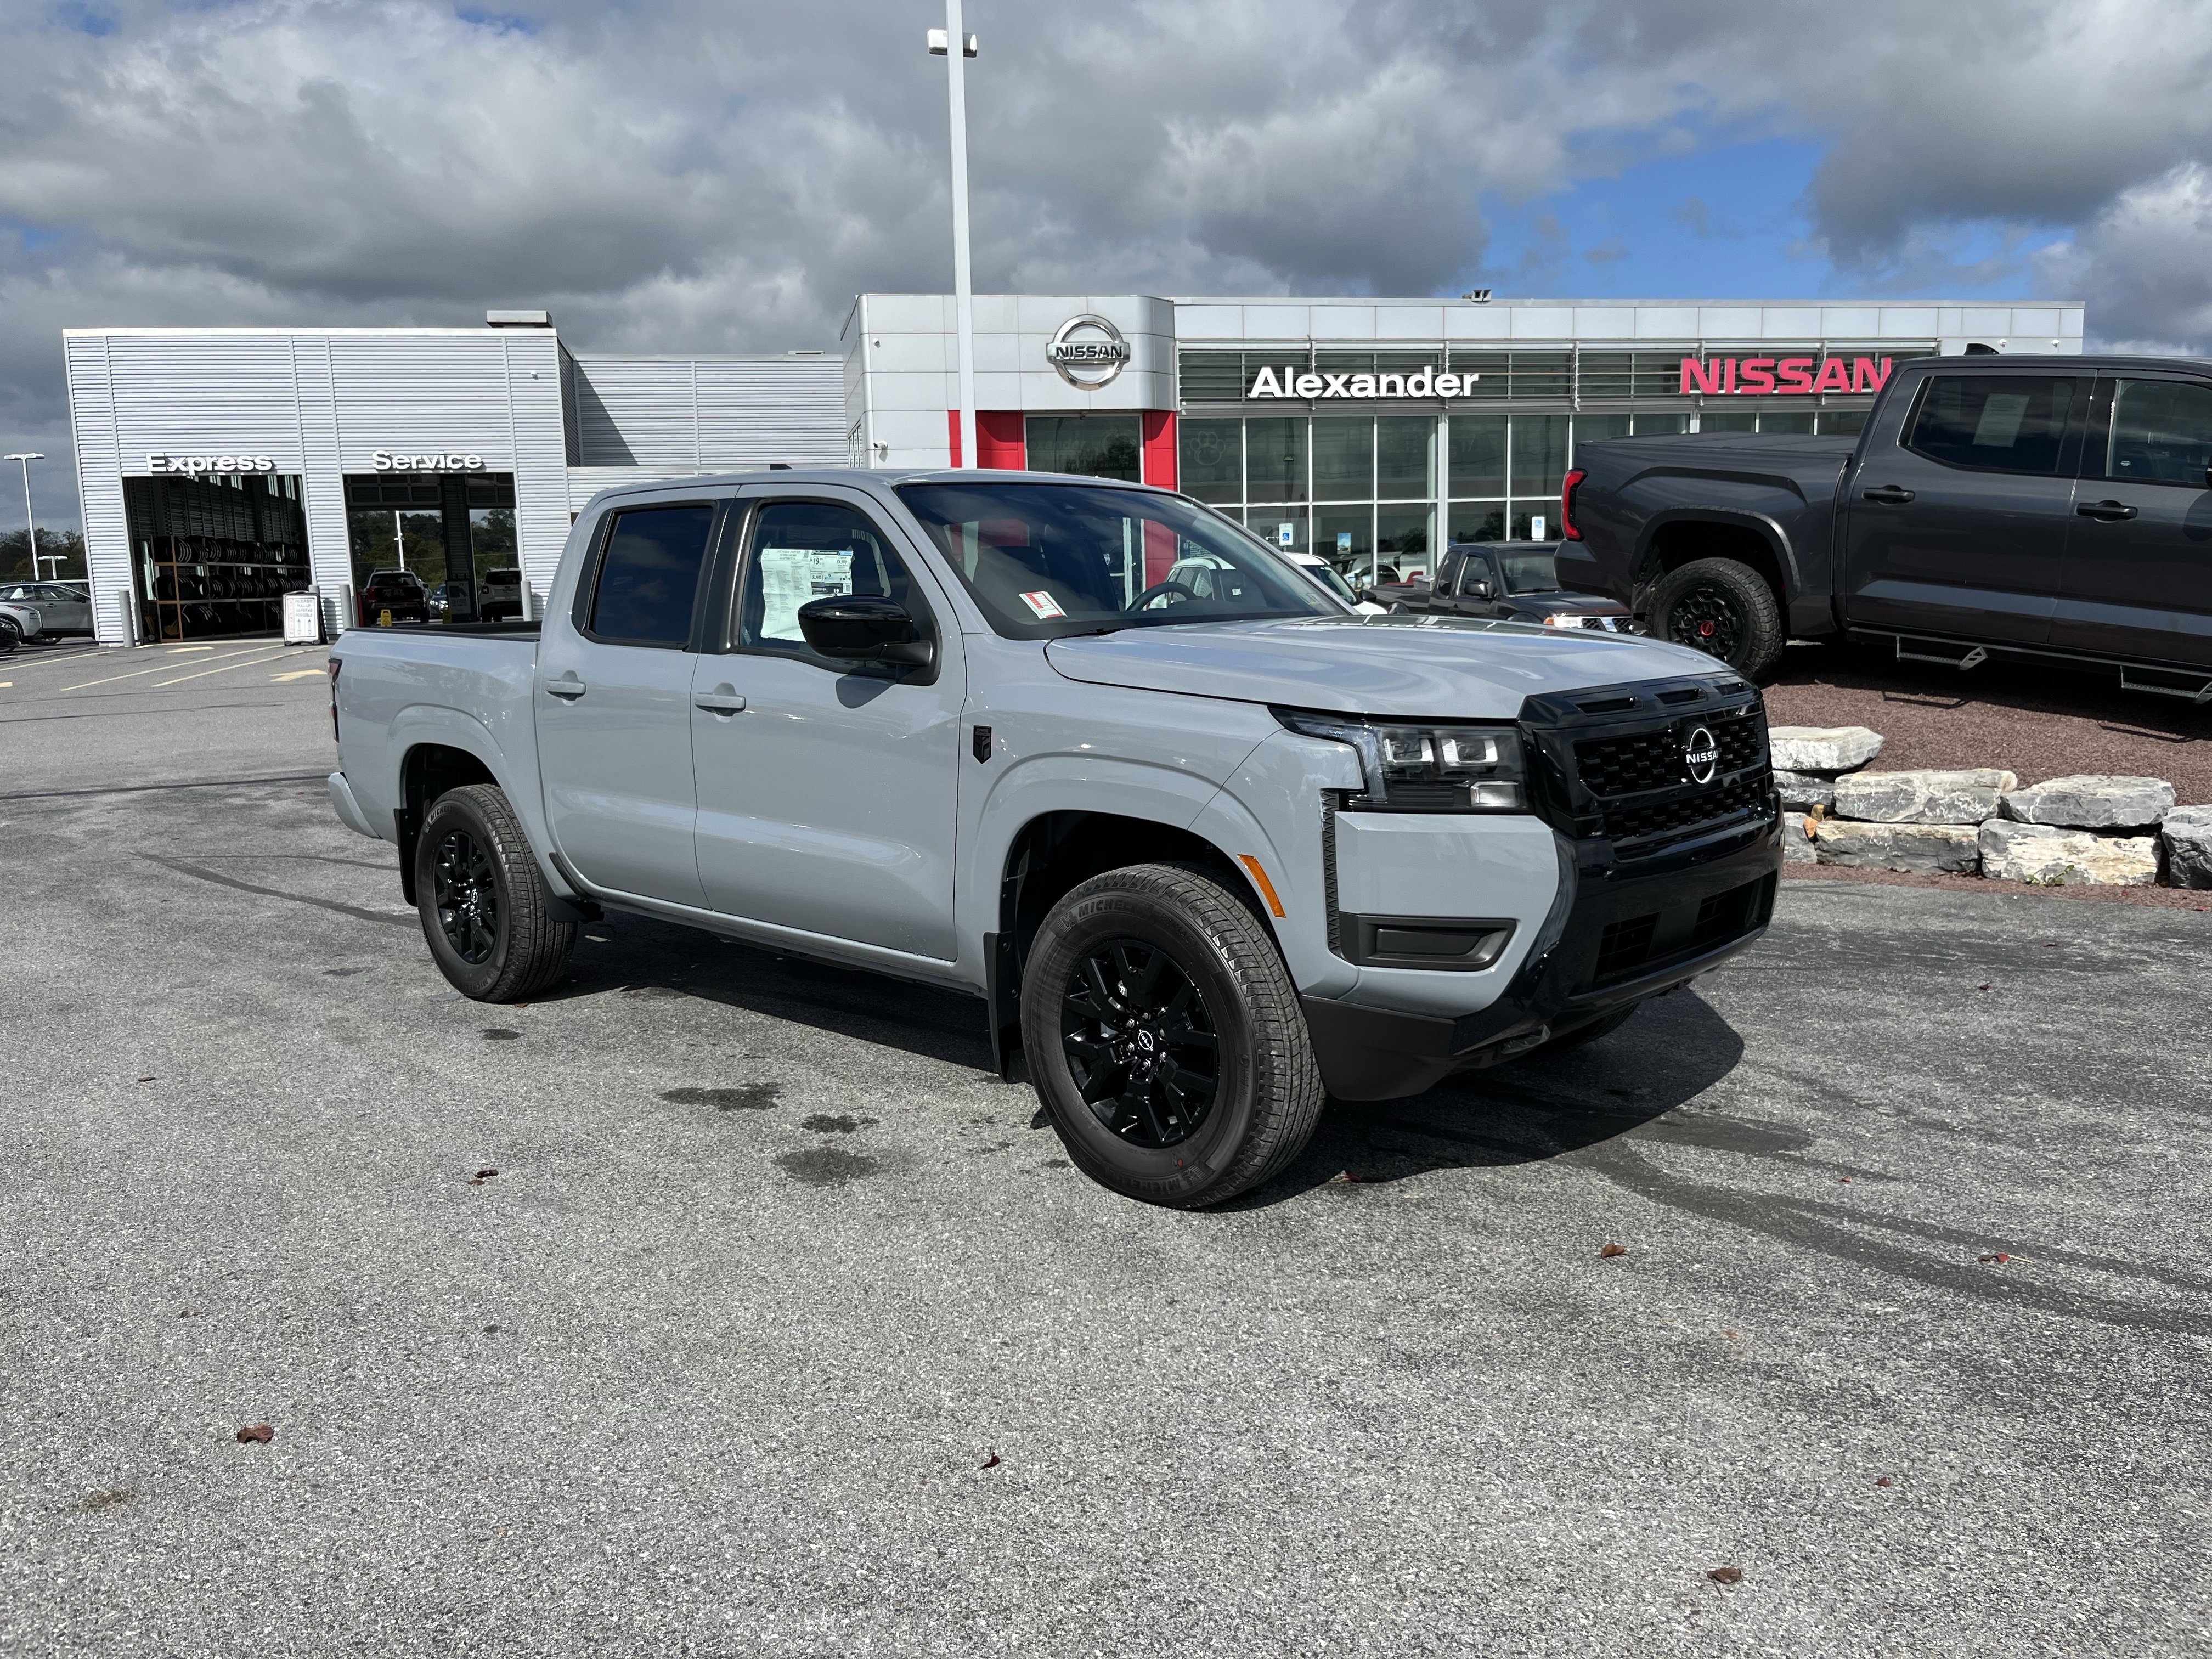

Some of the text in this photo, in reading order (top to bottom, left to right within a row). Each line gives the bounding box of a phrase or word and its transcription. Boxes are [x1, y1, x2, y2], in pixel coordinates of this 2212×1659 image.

[1056, 345, 1124, 359] NISSAN
[1249, 366, 1480, 398] Alexander
[1680, 357, 1892, 394] NISSAN
[145, 452, 272, 476] Express
[372, 450, 482, 470] Service
